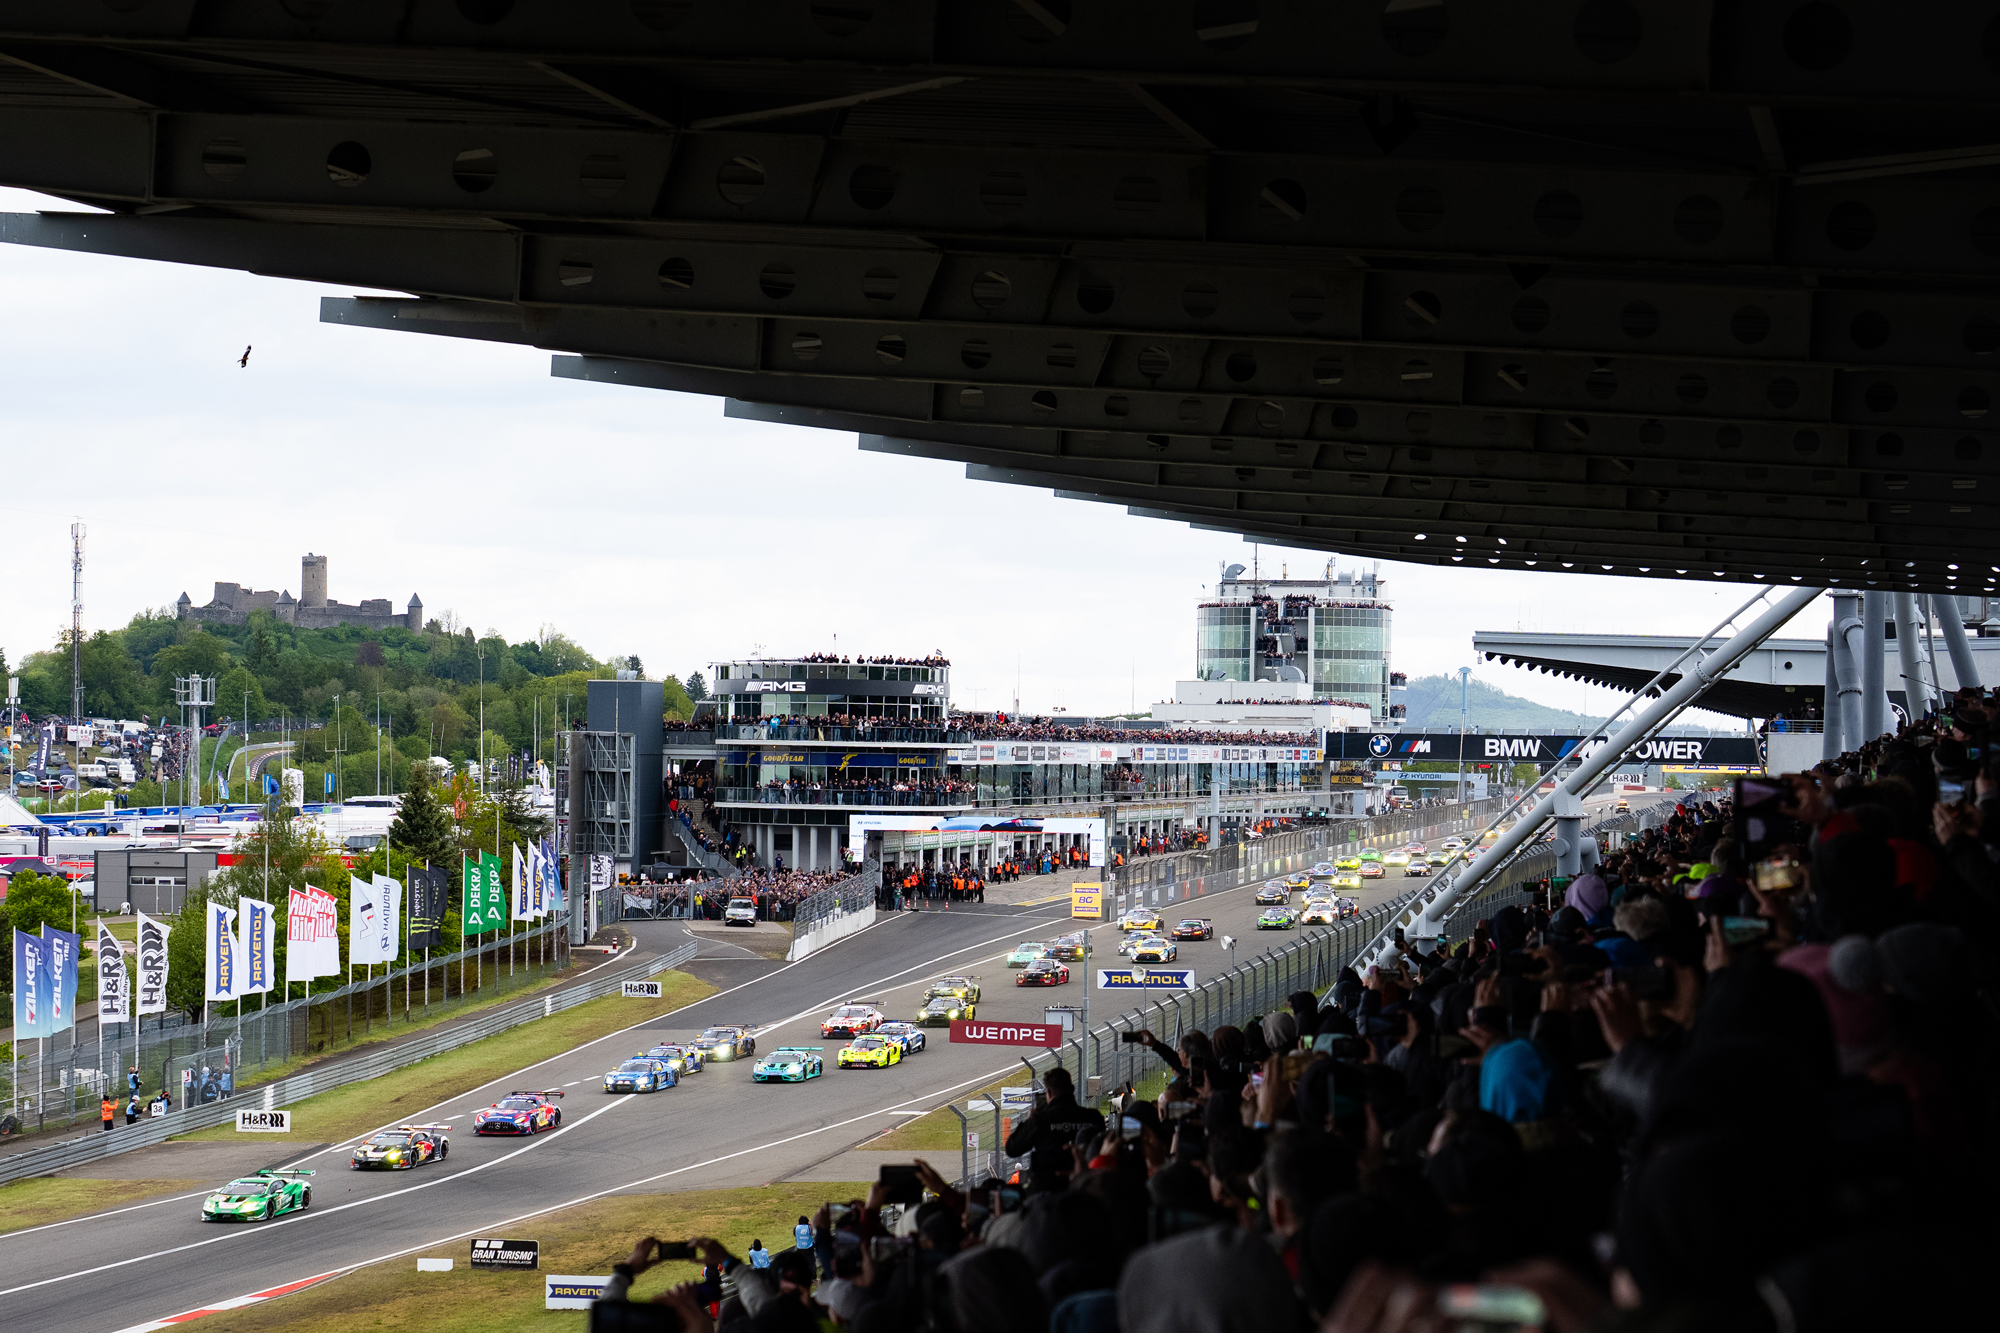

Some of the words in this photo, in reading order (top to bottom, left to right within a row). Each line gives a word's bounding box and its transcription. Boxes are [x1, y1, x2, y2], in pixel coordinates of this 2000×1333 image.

[759, 681, 806, 692] AMG
[1484, 738, 1542, 757] BMW
[1620, 740, 1703, 759] OWER
[763, 753, 804, 763] GOODYEAR
[899, 755, 927, 765] GOODYEAR
[1612, 774, 1630, 782] H&R
[470, 867, 482, 908] DEKRA
[291, 916, 316, 941] Bild
[253, 911, 263, 982] RAVENOL
[25, 942, 37, 1025] FALKEN
[53, 937, 64, 1019] FALKEN
[142, 955, 164, 1005] H&R
[102, 962, 121, 1014] H&R
[625, 983, 645, 993] H&R
[965, 1026, 1046, 1041] WEMPE
[153, 1104, 163, 1113] 3a
[242, 1113, 268, 1125] H&R
[472, 1249, 496, 1259] GRAN
[497, 1250, 534, 1261] TURISMO
[555, 1287, 602, 1296] RAVEN
